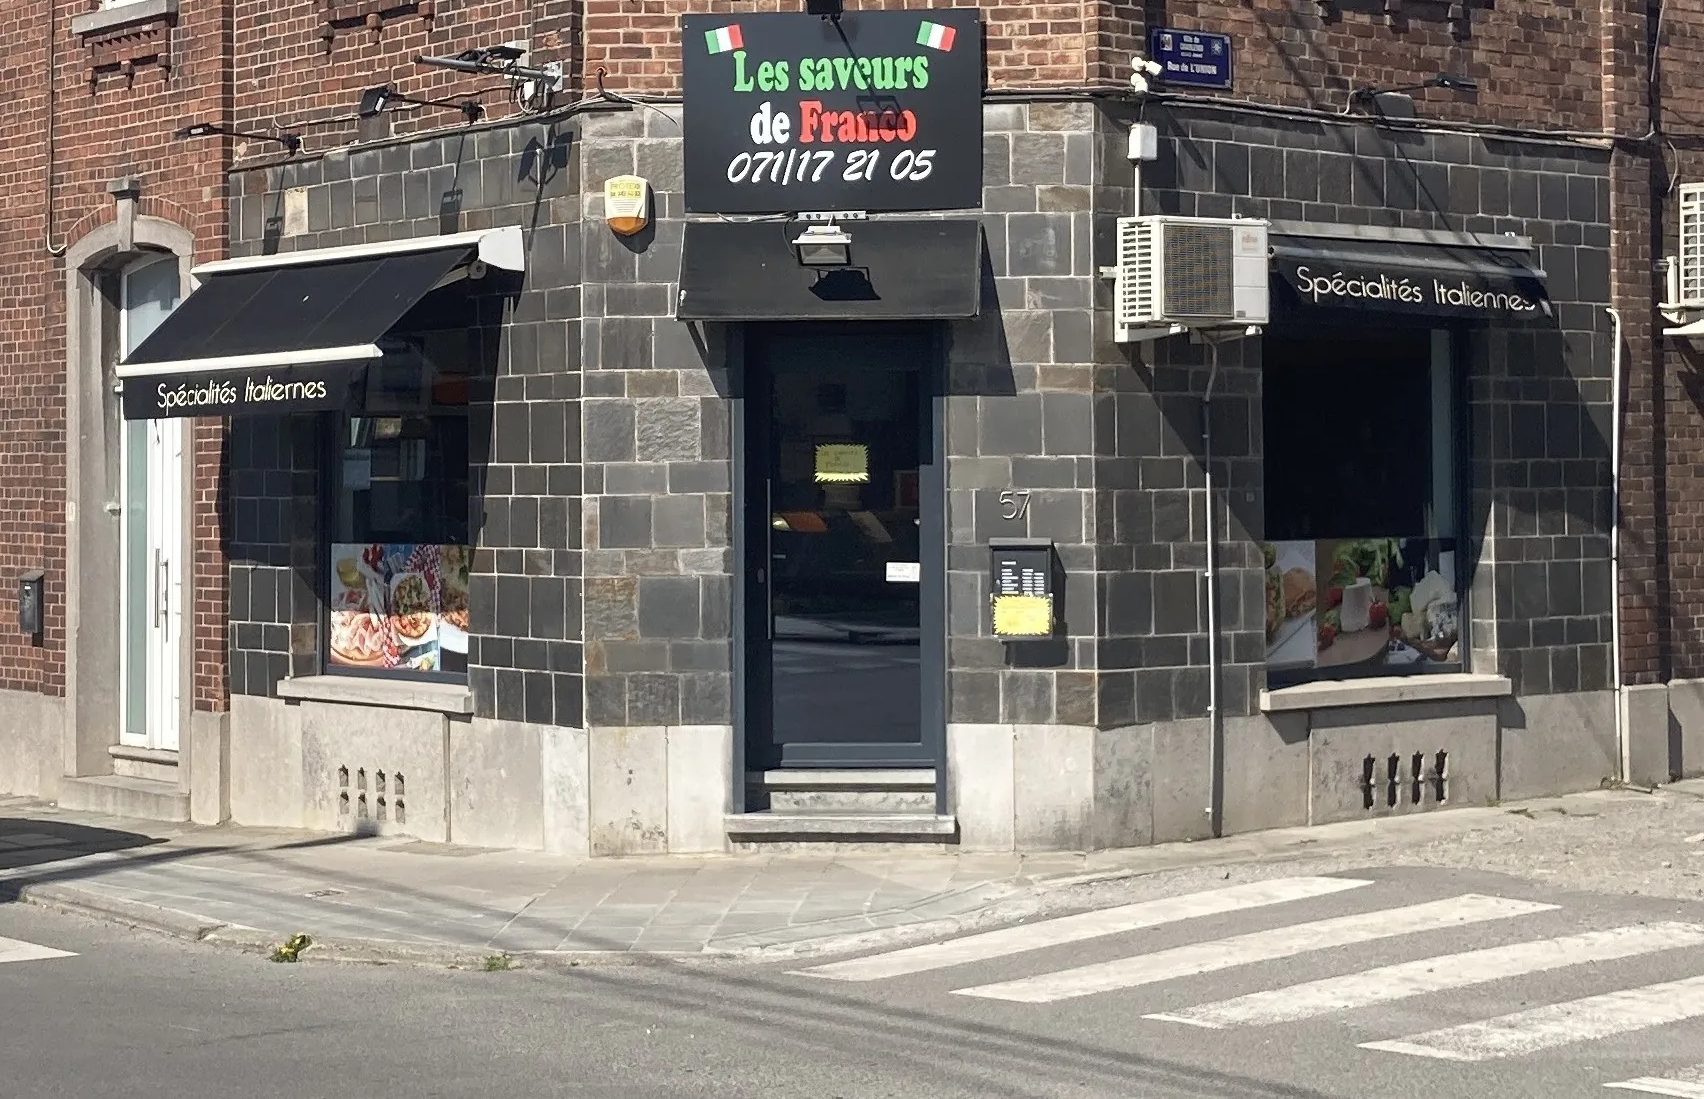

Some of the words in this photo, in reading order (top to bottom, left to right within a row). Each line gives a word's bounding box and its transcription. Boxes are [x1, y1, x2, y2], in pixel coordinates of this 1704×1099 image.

[733, 50, 790, 92] Les
[798, 54, 929, 91] saveurs
[750, 101, 790, 145] de
[799, 100, 917, 143] Franco
[842, 149, 880, 181] 21
[890, 149, 937, 181] 05
[1296, 266, 1423, 302] Spécialités
[1433, 278, 1536, 311] Italiennes
[157, 379, 237, 416] Spécialités
[999, 490, 1031, 519] 57
